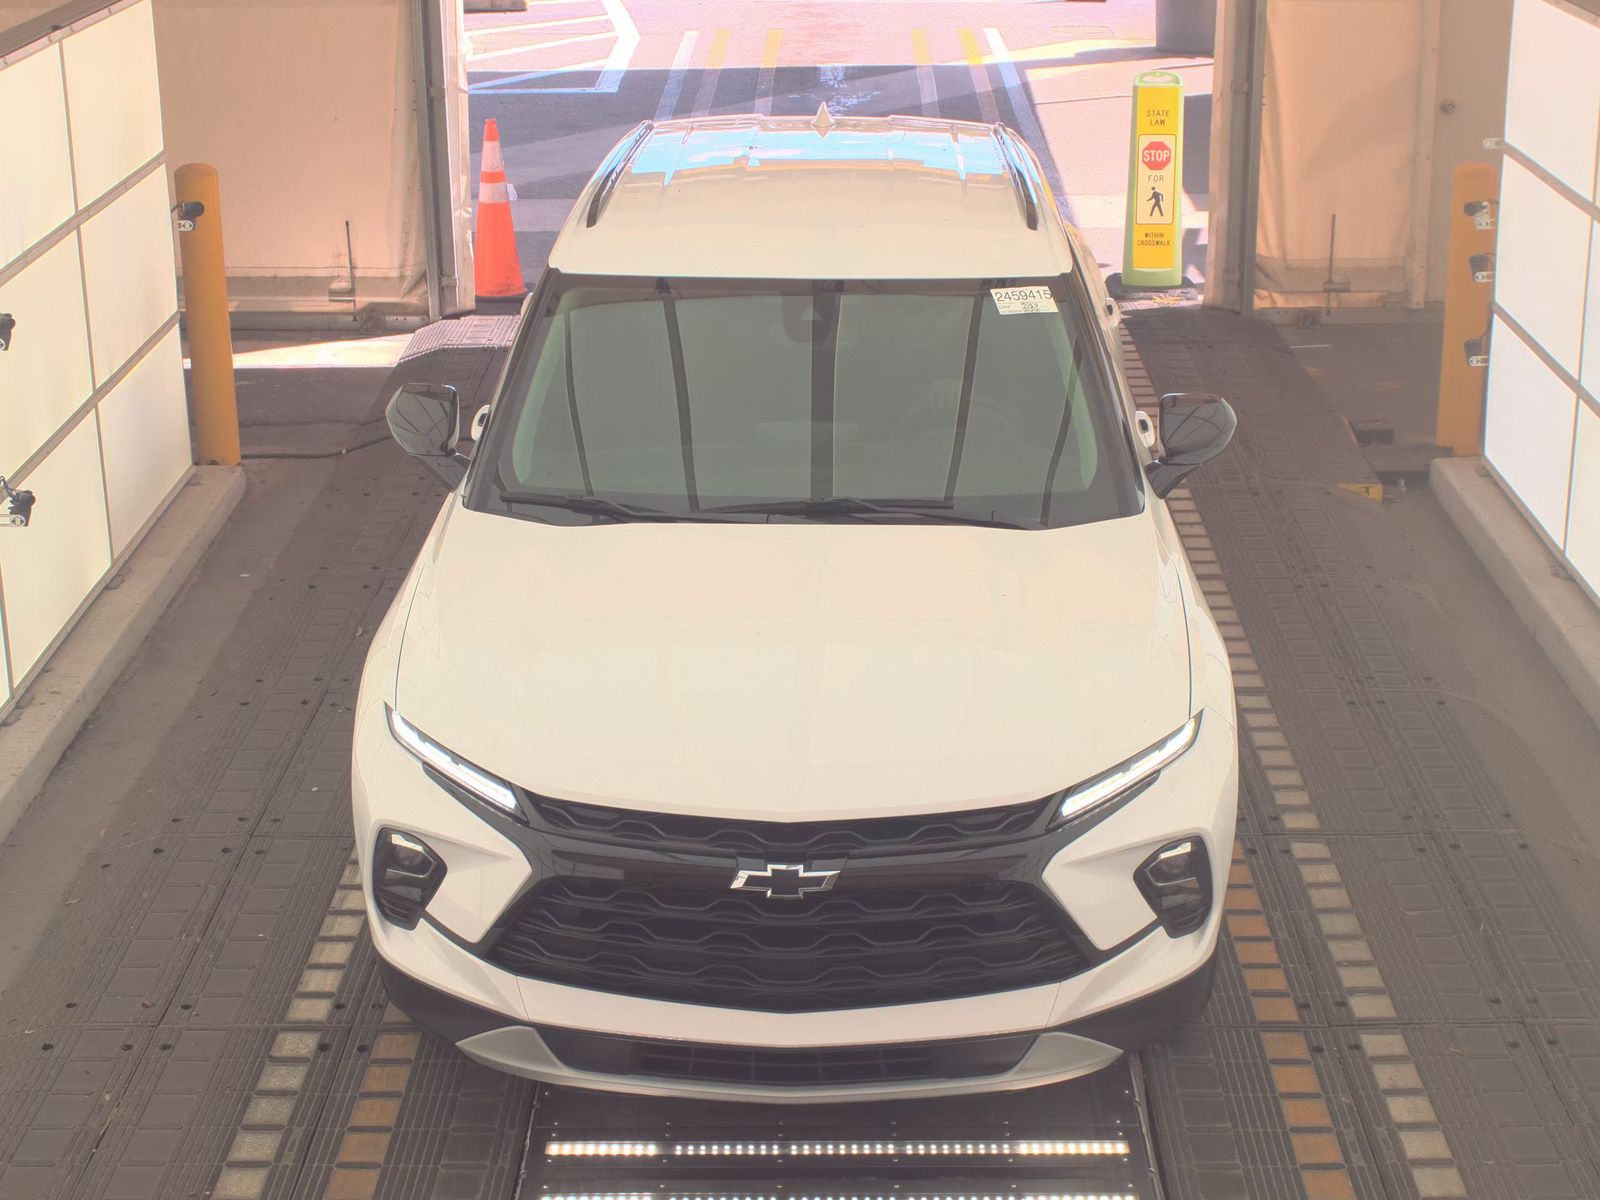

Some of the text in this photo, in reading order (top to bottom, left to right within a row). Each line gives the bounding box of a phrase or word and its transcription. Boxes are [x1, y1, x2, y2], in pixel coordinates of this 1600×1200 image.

[1146, 109, 1169, 117] STATE
[1143, 149, 1170, 162] STOP
[1147, 174, 1164, 182] FOR
[1137, 239, 1171, 247] CROSSWALK
[995, 290, 1053, 301] 2459415
